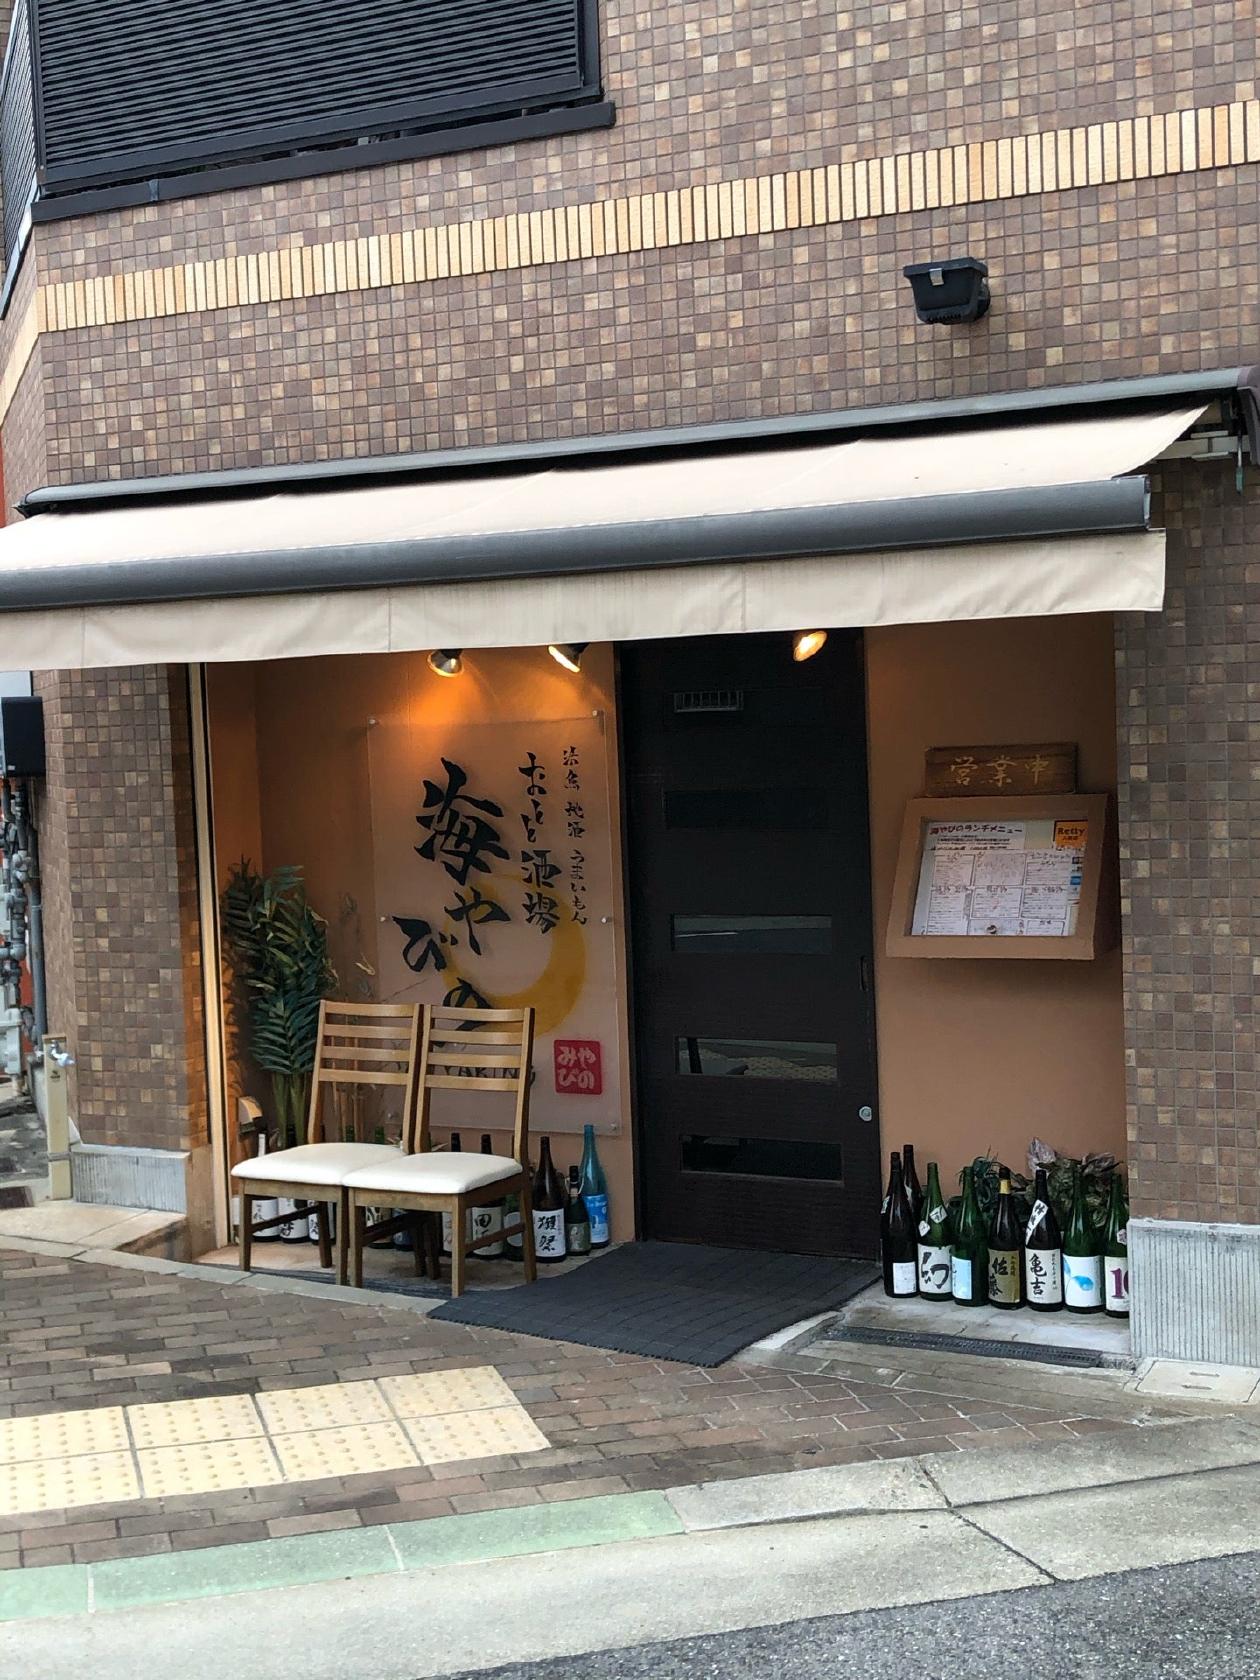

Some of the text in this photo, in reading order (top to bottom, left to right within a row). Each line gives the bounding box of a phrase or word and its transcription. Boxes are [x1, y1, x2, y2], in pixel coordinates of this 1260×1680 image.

[949, 753, 1051, 788] 営業中
[517, 751, 562, 935] おとと酒場
[1057, 827, 1086, 837] Retty
[569, 848, 588, 926] うまいもん
[921, 1251, 950, 1290] 幻
[1029, 1253, 1047, 1296] 亀吉
